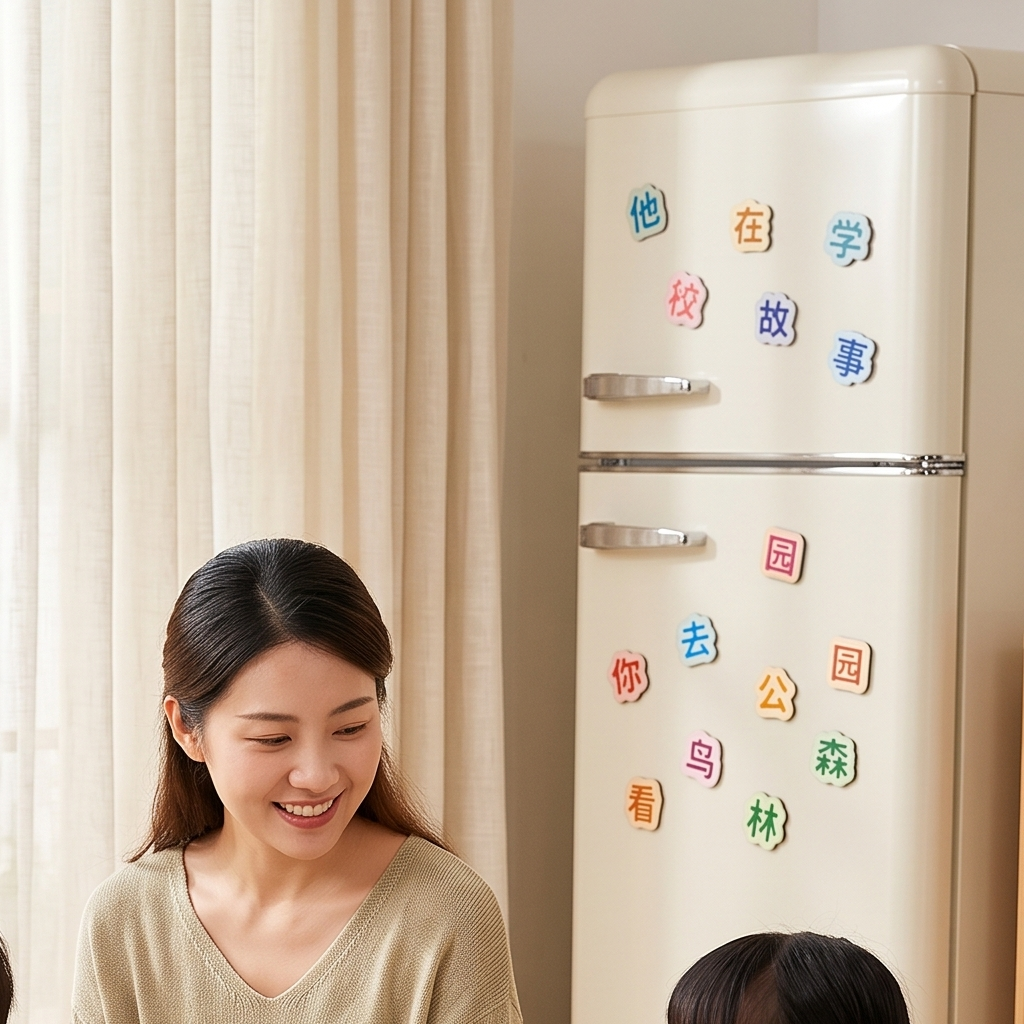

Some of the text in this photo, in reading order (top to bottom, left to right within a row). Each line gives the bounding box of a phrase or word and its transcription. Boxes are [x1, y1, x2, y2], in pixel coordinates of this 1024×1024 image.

[630, 191, 863, 258] 他 在 学
[668, 279, 868, 377] 校 故 事
[765, 535, 798, 576] 园
[681, 621, 709, 659] 去
[611, 645, 863, 713] 你 公 园
[686, 738, 848, 779] 鸟 森
[628, 784, 778, 842] 看 林
